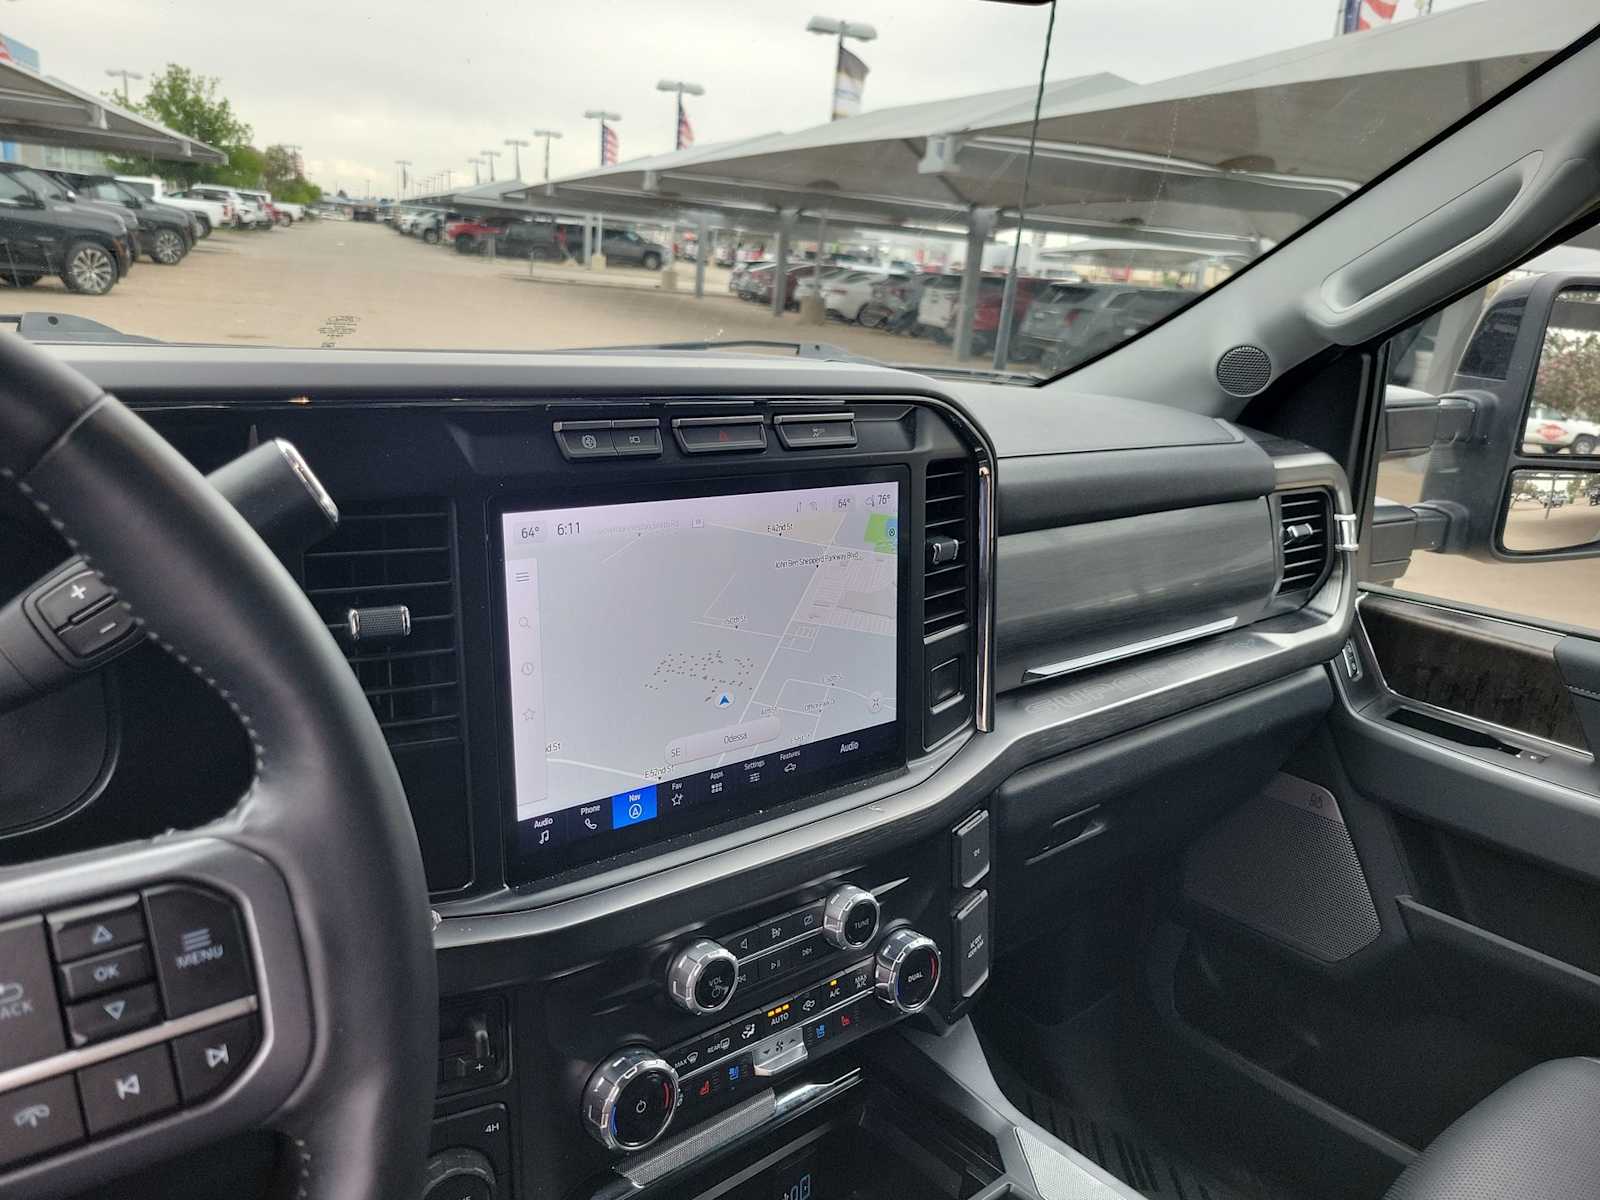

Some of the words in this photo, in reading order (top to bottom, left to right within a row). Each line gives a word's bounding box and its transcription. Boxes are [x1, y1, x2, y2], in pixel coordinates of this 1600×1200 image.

[521, 526, 540, 539] 64°
[557, 522, 581, 536] 6:11
[840, 740, 859, 753] Audio
[671, 747, 681, 758] SE
[780, 750, 801, 761] Features
[744, 759, 765, 771] Settings
[710, 770, 723, 780] Apps
[672, 782, 682, 790] Fav
[629, 793, 641, 802] Nav
[580, 804, 600, 816] Phone
[534, 817, 553, 829] Audio
[854, 918, 870, 929] TUNE
[176, 945, 223, 969] MENU
[94, 963, 120, 981] OK
[908, 971, 923, 983] DUAL
[709, 976, 722, 986] VOL
[829, 988, 841, 998] A/C
[771, 1012, 789, 1025] AUTO
[675, 1058, 687, 1068] MAX
[484, 1122, 500, 1133] 4H
